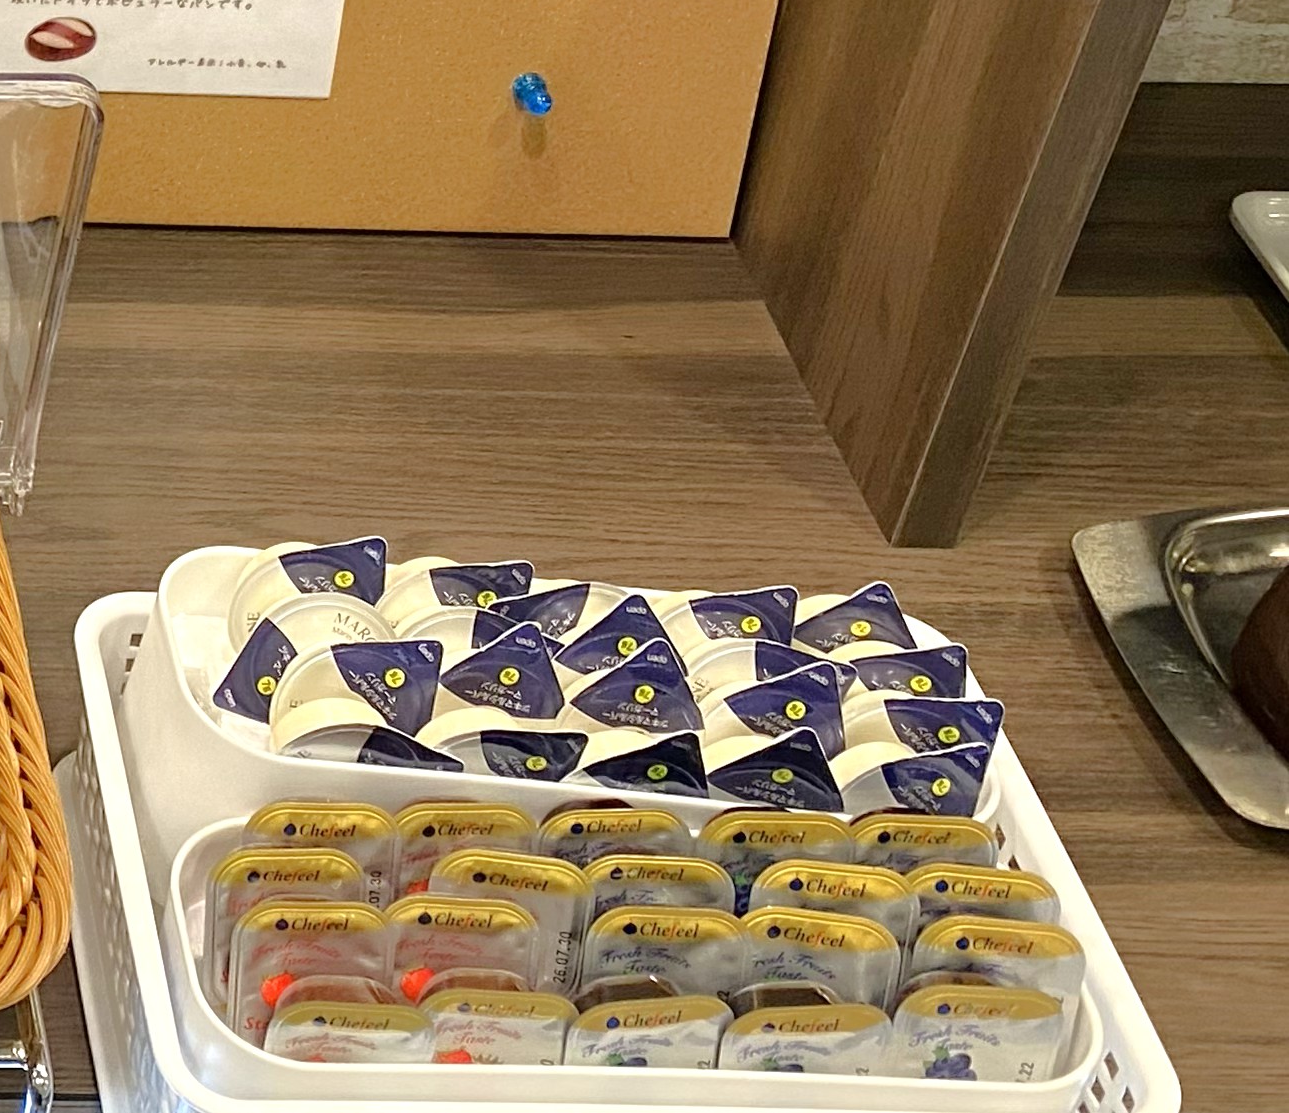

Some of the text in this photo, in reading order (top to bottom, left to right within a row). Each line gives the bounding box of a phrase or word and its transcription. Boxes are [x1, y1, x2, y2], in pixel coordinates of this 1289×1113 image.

[299, 823, 357, 838] Chefeel
[437, 823, 494, 837] Chefeel
[587, 819, 642, 834] Chefeel
[748, 829, 807, 845] Chefeel
[892, 829, 951, 845] Chefeel
[262, 870, 321, 883] Chefeel
[625, 867, 685, 882] Chefeel
[489, 873, 550, 893] Chefeel
[805, 878, 867, 900] Chefeel
[950, 879, 1013, 900] Chefeel
[290, 917, 350, 932] Chefeel
[433, 912, 493, 929] Chefeel
[639, 922, 701, 939] Chefeel
[783, 926, 846, 949] Chefeel
[971, 935, 1035, 956] Chefeel
[551, 931, 573, 985] 26.07.30
[753, 952, 786, 968] resh
[622, 1010, 683, 1030] Chefeel
[777, 1019, 841, 1034] Chefeel
